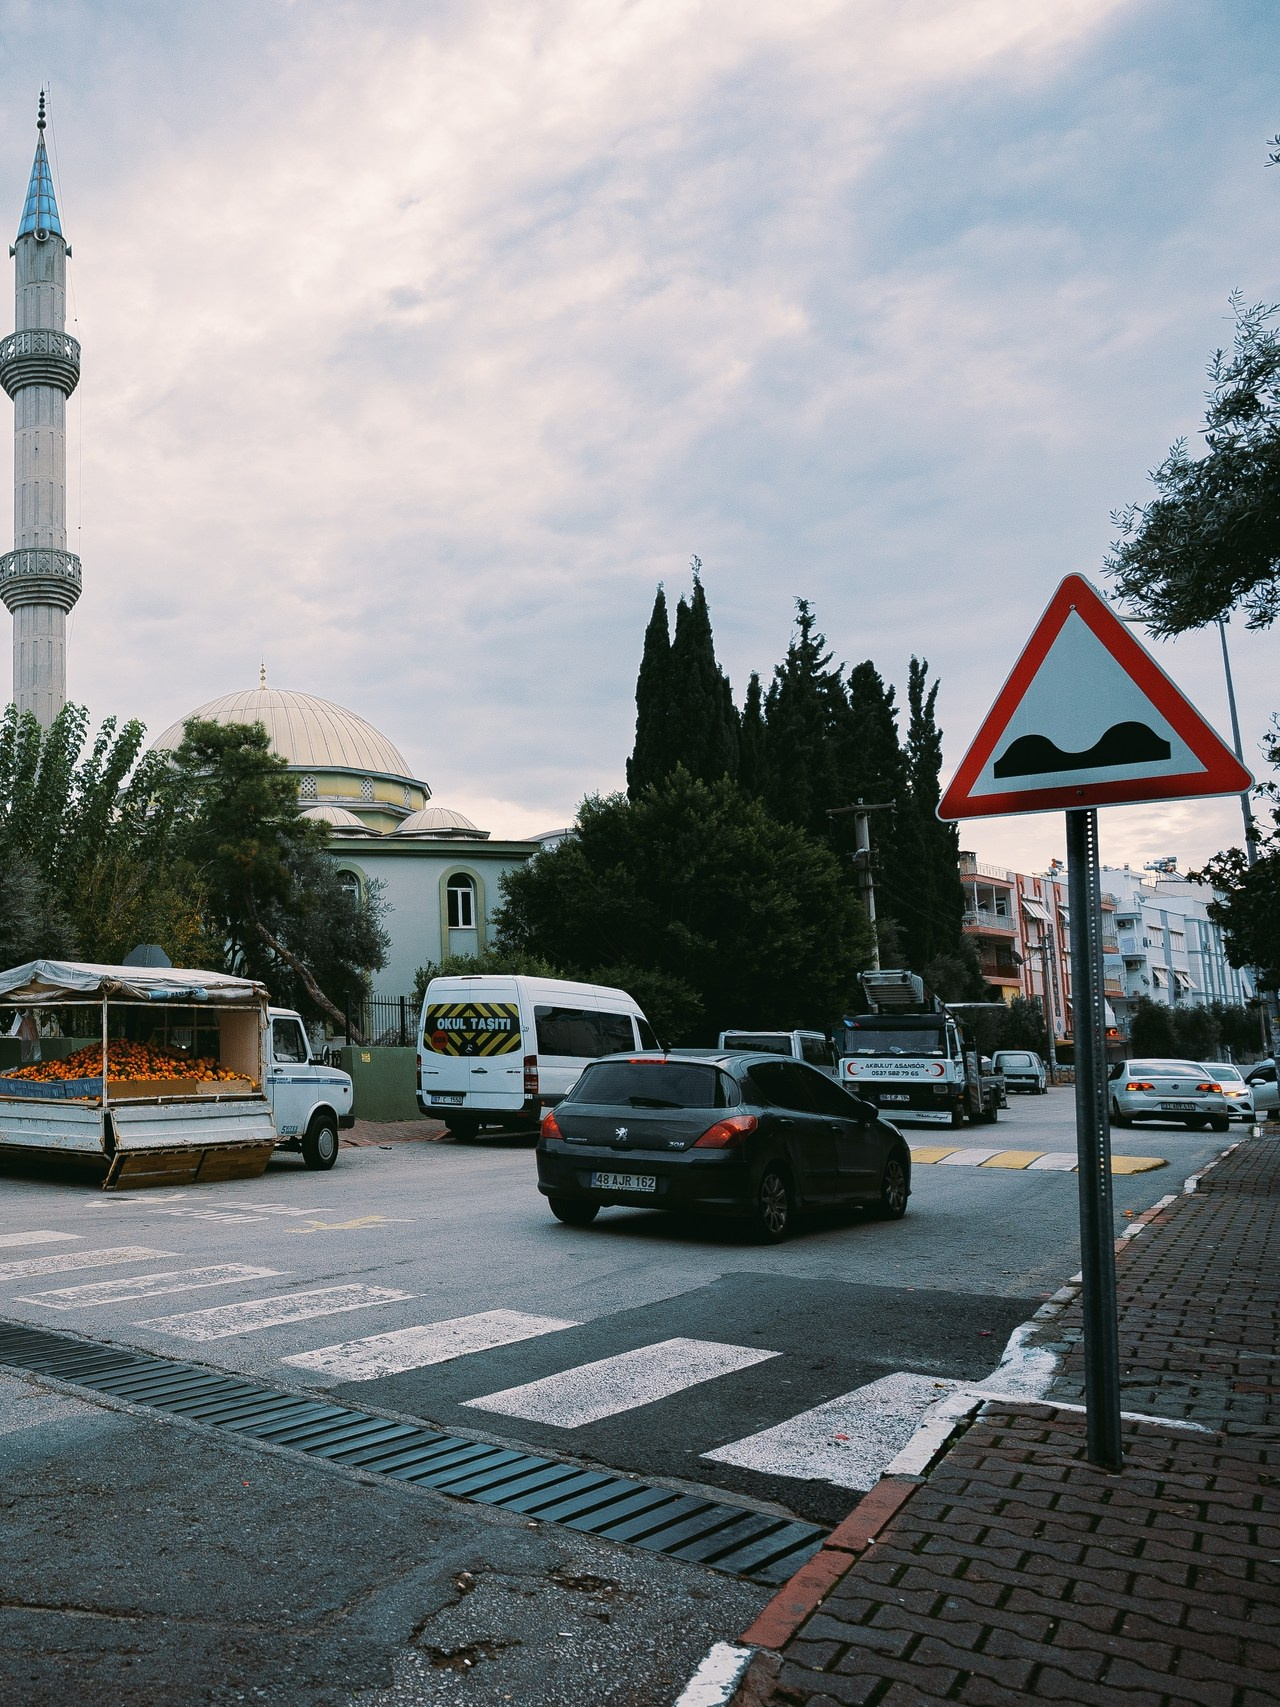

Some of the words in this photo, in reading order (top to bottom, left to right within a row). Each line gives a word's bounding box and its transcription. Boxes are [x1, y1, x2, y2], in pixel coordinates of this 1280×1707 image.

[437, 1018, 466, 1030] OKUL
[470, 1018, 511, 1031] TAŞITI
[281, 1125, 287, 1134] 5
[596, 1173, 609, 1185] 48
[612, 1174, 632, 1187] AJR
[635, 1176, 655, 1188] 162
